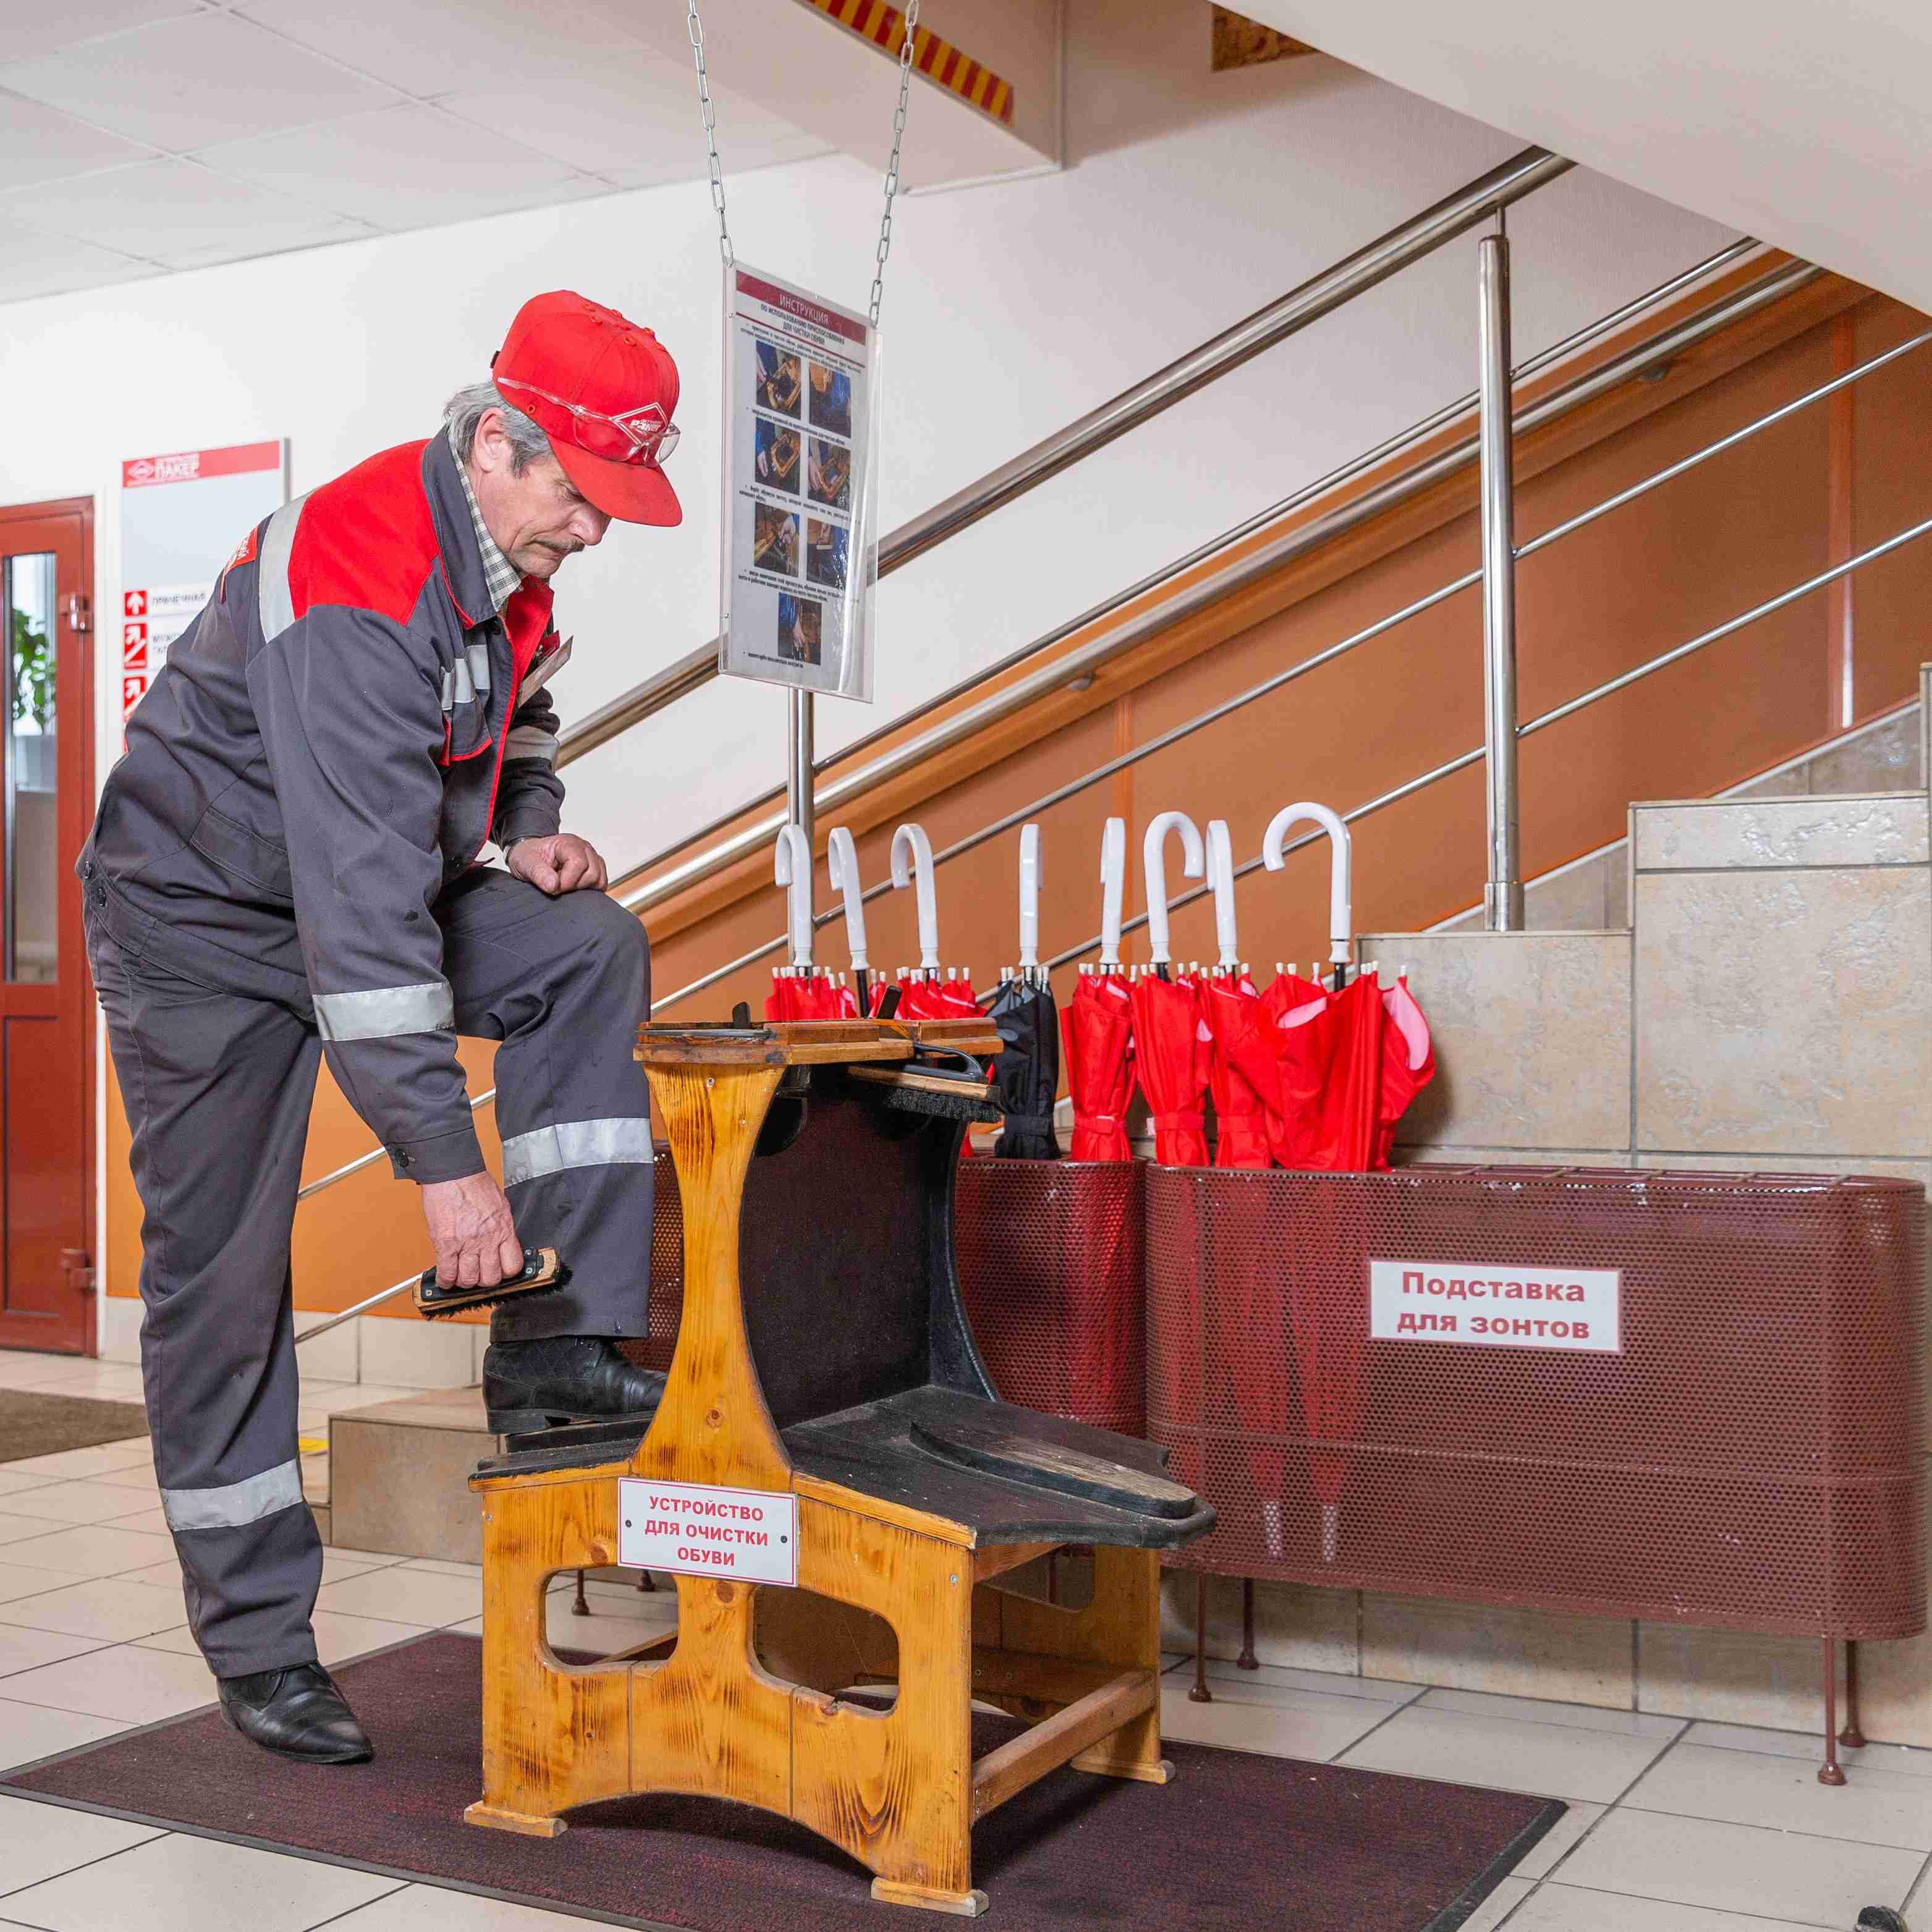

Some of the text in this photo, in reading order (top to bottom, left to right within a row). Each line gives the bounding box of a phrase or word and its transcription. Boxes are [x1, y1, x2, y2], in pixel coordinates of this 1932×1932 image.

[779, 294, 829, 326] ИНСТРУКЦИЯ
[1402, 1271, 1585, 1302] Подставка
[1397, 1313, 1590, 1339] для зонтов
[649, 1496, 763, 1522] УСТРОЙСТВО
[645, 1519, 768, 1546] ДЛЯ ОЧИСТКИ
[677, 1546, 735, 1566] ОБУВИ
